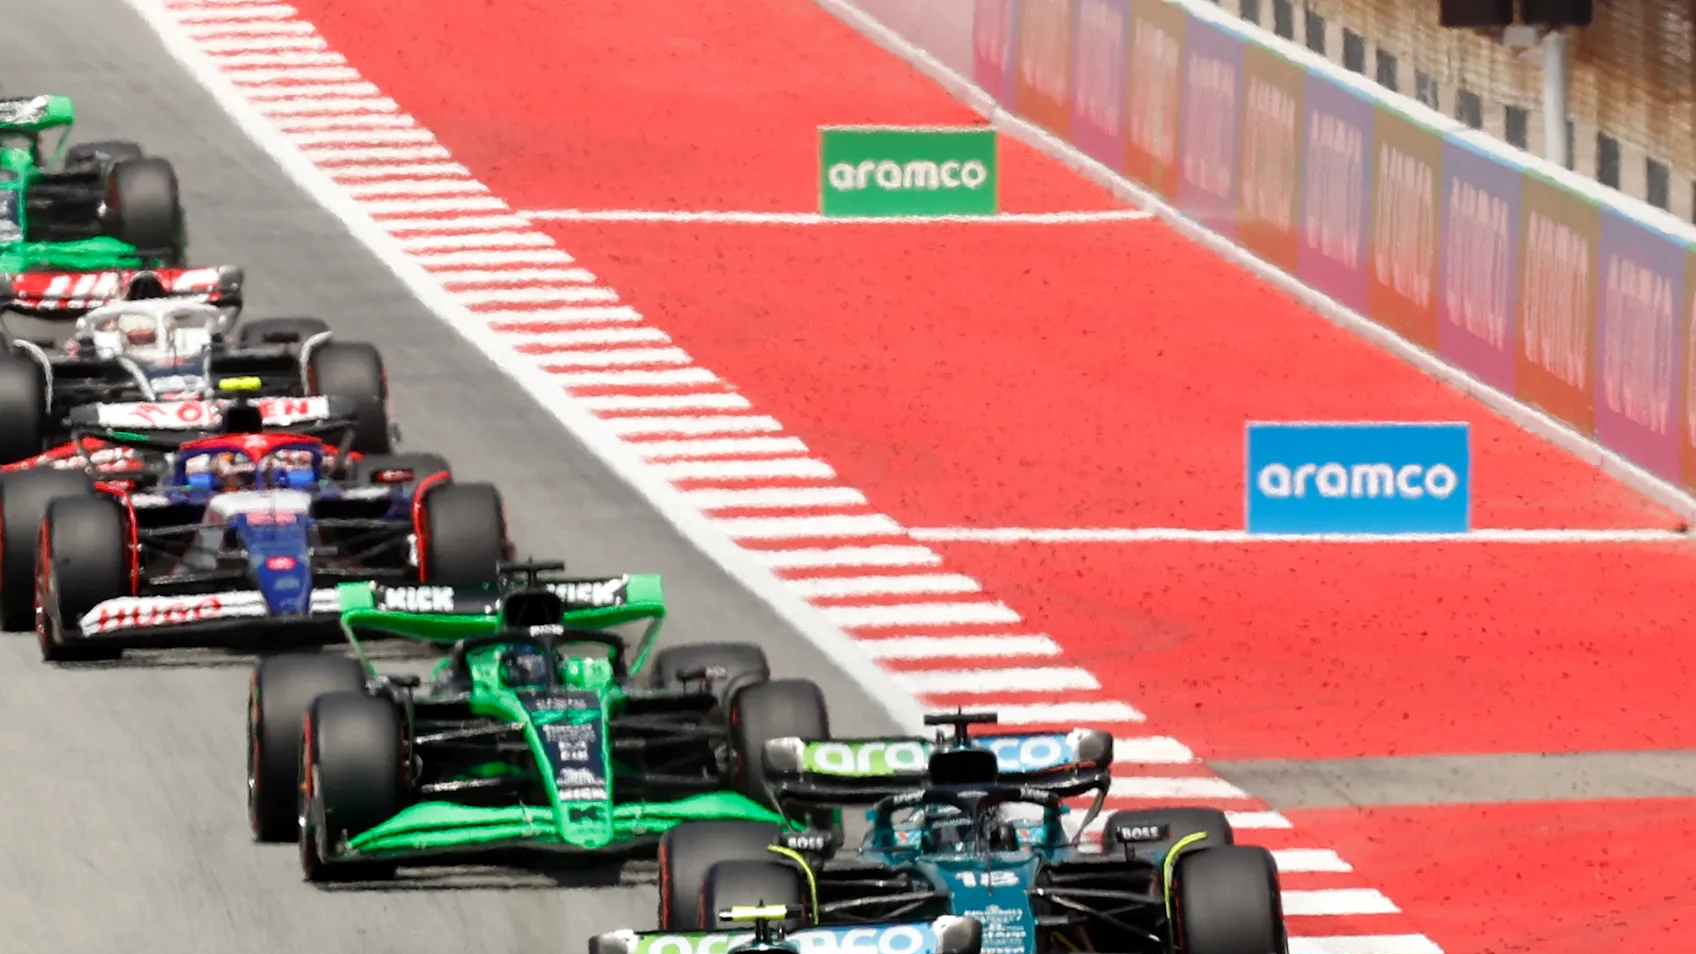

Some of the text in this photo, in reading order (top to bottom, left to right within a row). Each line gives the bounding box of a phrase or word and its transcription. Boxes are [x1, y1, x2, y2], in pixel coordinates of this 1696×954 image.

[827, 159, 988, 191] aramco
[176, 398, 310, 423] OEN
[1257, 462, 1457, 500] aramco
[384, 584, 455, 611] KICK
[98, 594, 222, 633] HUGO
[813, 736, 1062, 773] araco
[787, 836, 825, 851] BOSS
[1121, 825, 1159, 841] BOSS
